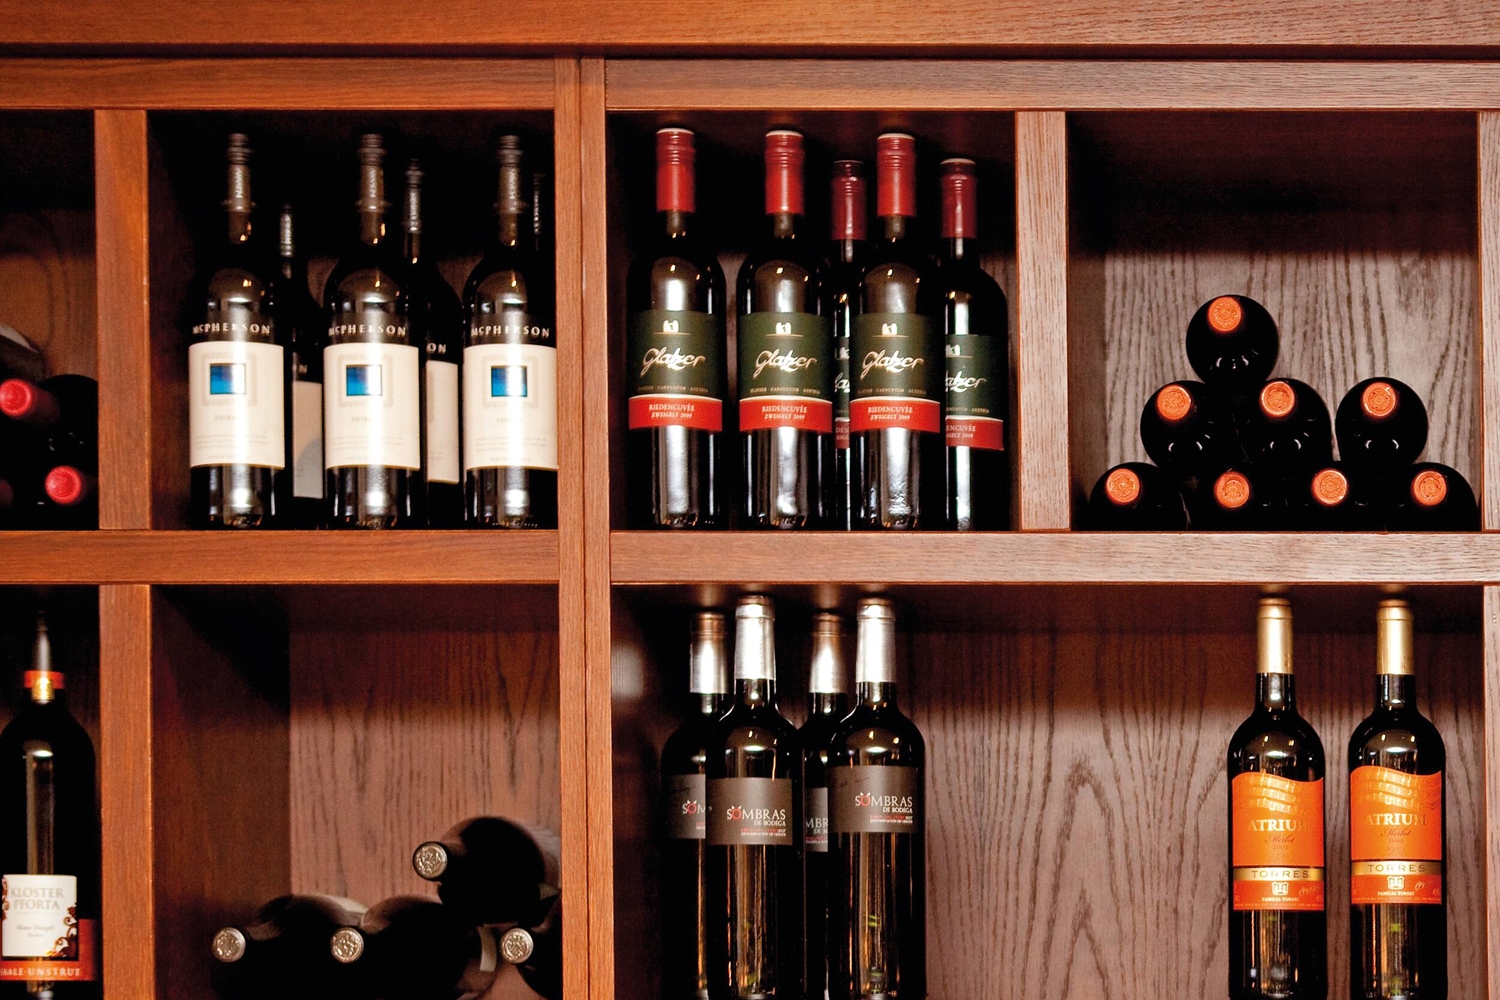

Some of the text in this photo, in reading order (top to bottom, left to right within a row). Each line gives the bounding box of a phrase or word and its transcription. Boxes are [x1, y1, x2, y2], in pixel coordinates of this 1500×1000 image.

[640, 346, 706, 377] Glatzer
[752, 348, 818, 378] Glatzer
[860, 349, 924, 380] Glatzer
[946, 371, 987, 393] atzer
[649, 403, 695, 412] RIEDENCUVÉE
[762, 404, 808, 413] RIEDENCUVÉE
[867, 404, 914, 414] RIEDENCUVÉE
[946, 424, 977, 432] ENCUVÉE
[855, 792, 913, 807] SOMBRAS
[726, 805, 786, 820] SOMBRAS
[892, 806, 913, 814] BODEGA
[1366, 813, 1427, 826] ATRIUM
[1247, 818, 1310, 832] ATRIUM
[1380, 828, 1412, 836] Merlot
[1264, 834, 1295, 843] Merlot
[1368, 864, 1426, 872] TORRES
[1251, 870, 1311, 878] TORRES
[13, 899, 60, 910] PFORTA
